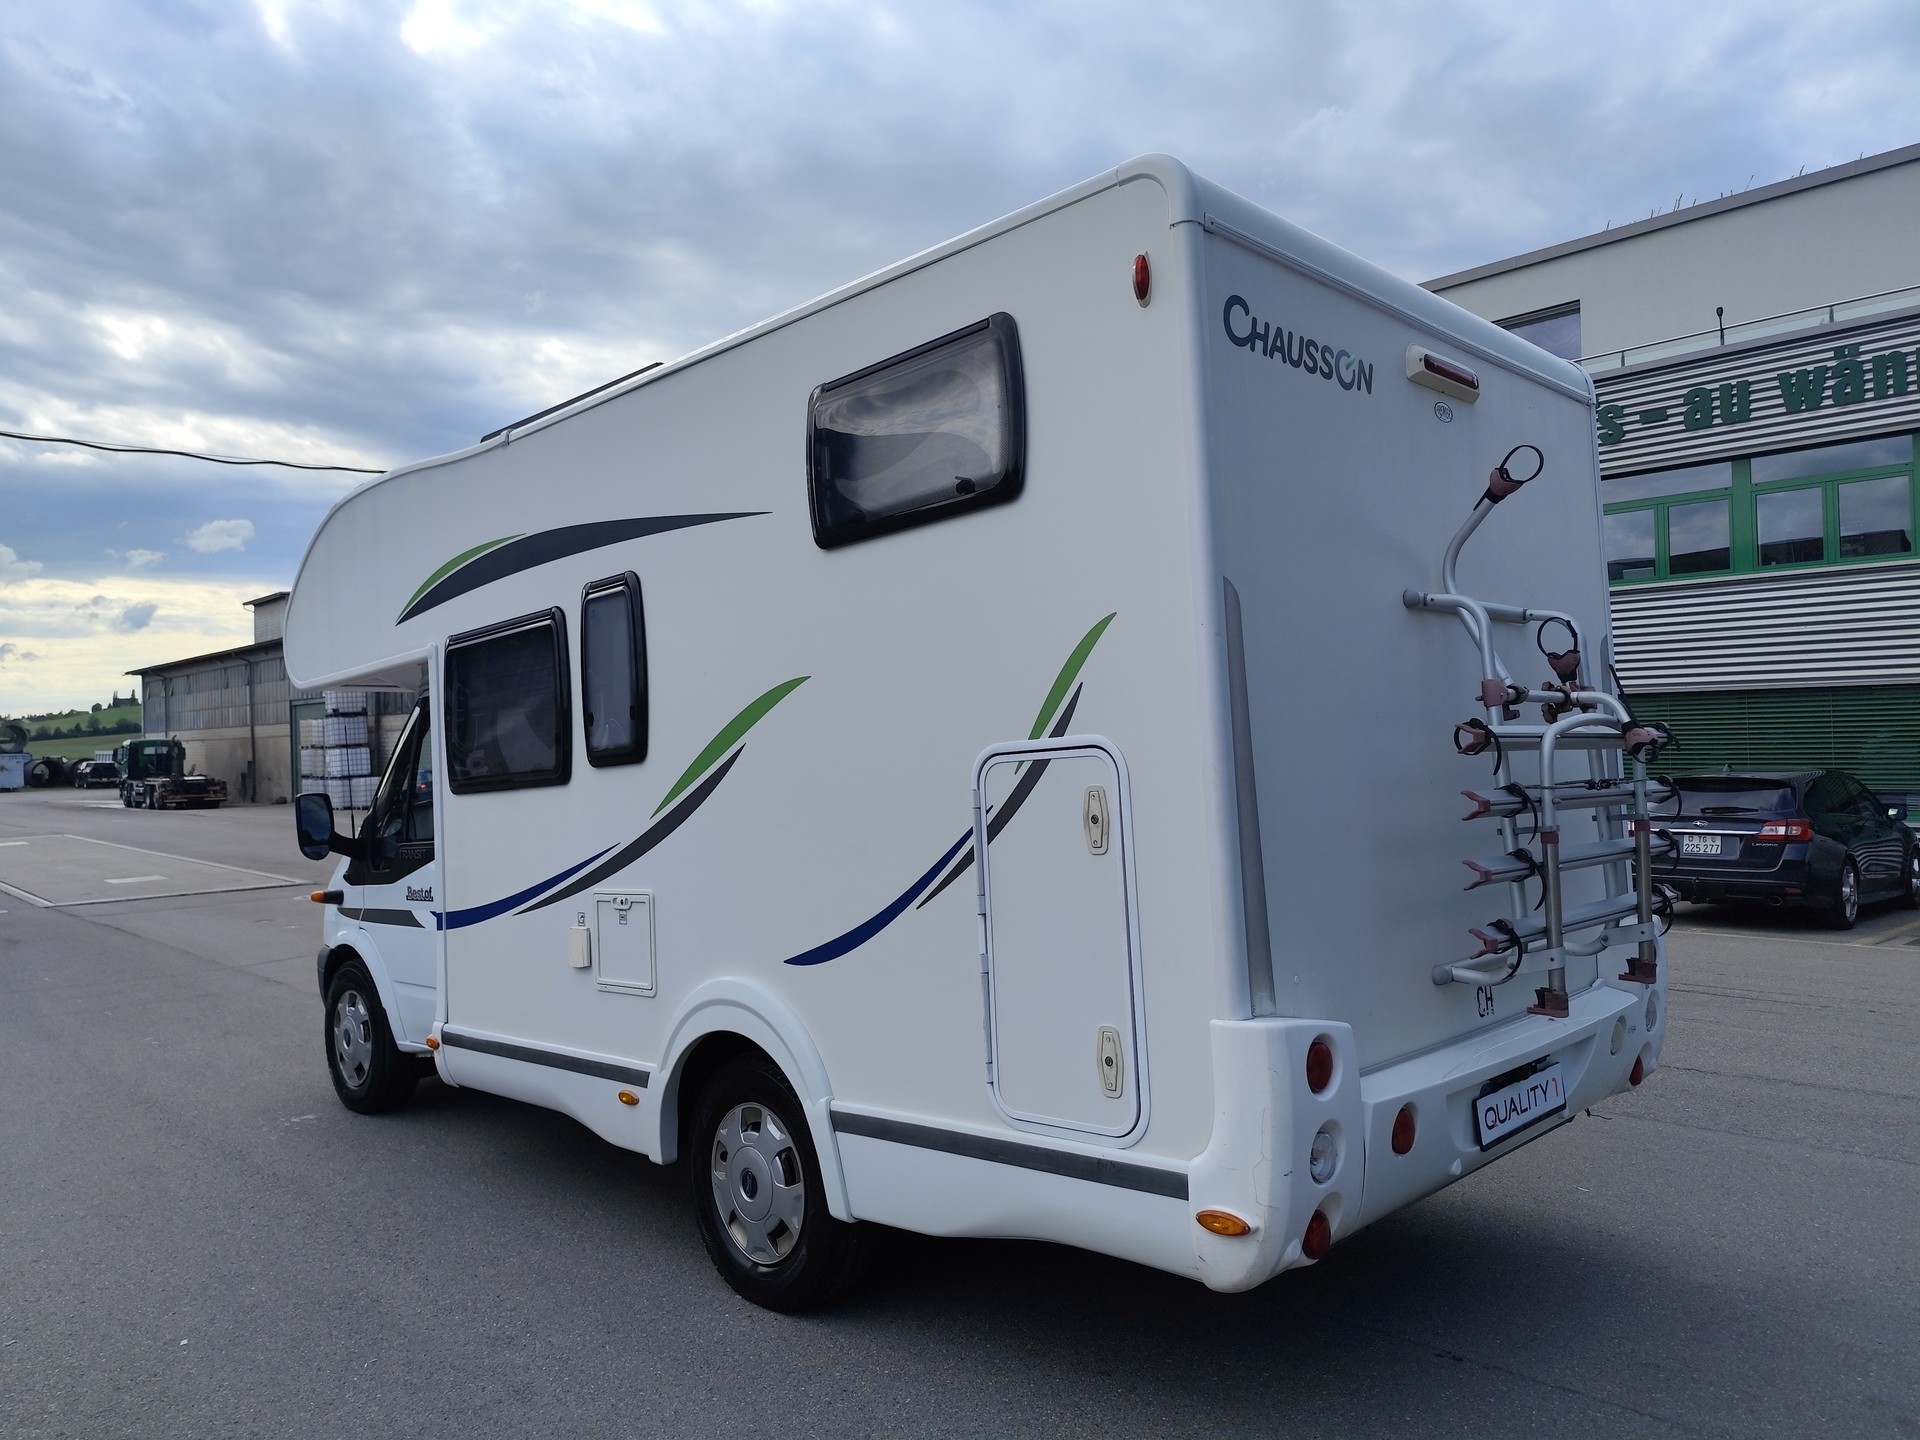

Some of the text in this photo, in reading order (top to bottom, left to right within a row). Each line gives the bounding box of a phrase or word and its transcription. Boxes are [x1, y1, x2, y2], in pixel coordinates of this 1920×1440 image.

[1777, 344, 1920, 415] wän
[1684, 843, 1720, 853] 225 277
[1476, 986, 1494, 1017] CH
[1484, 1079, 1549, 1130] QUALITY
